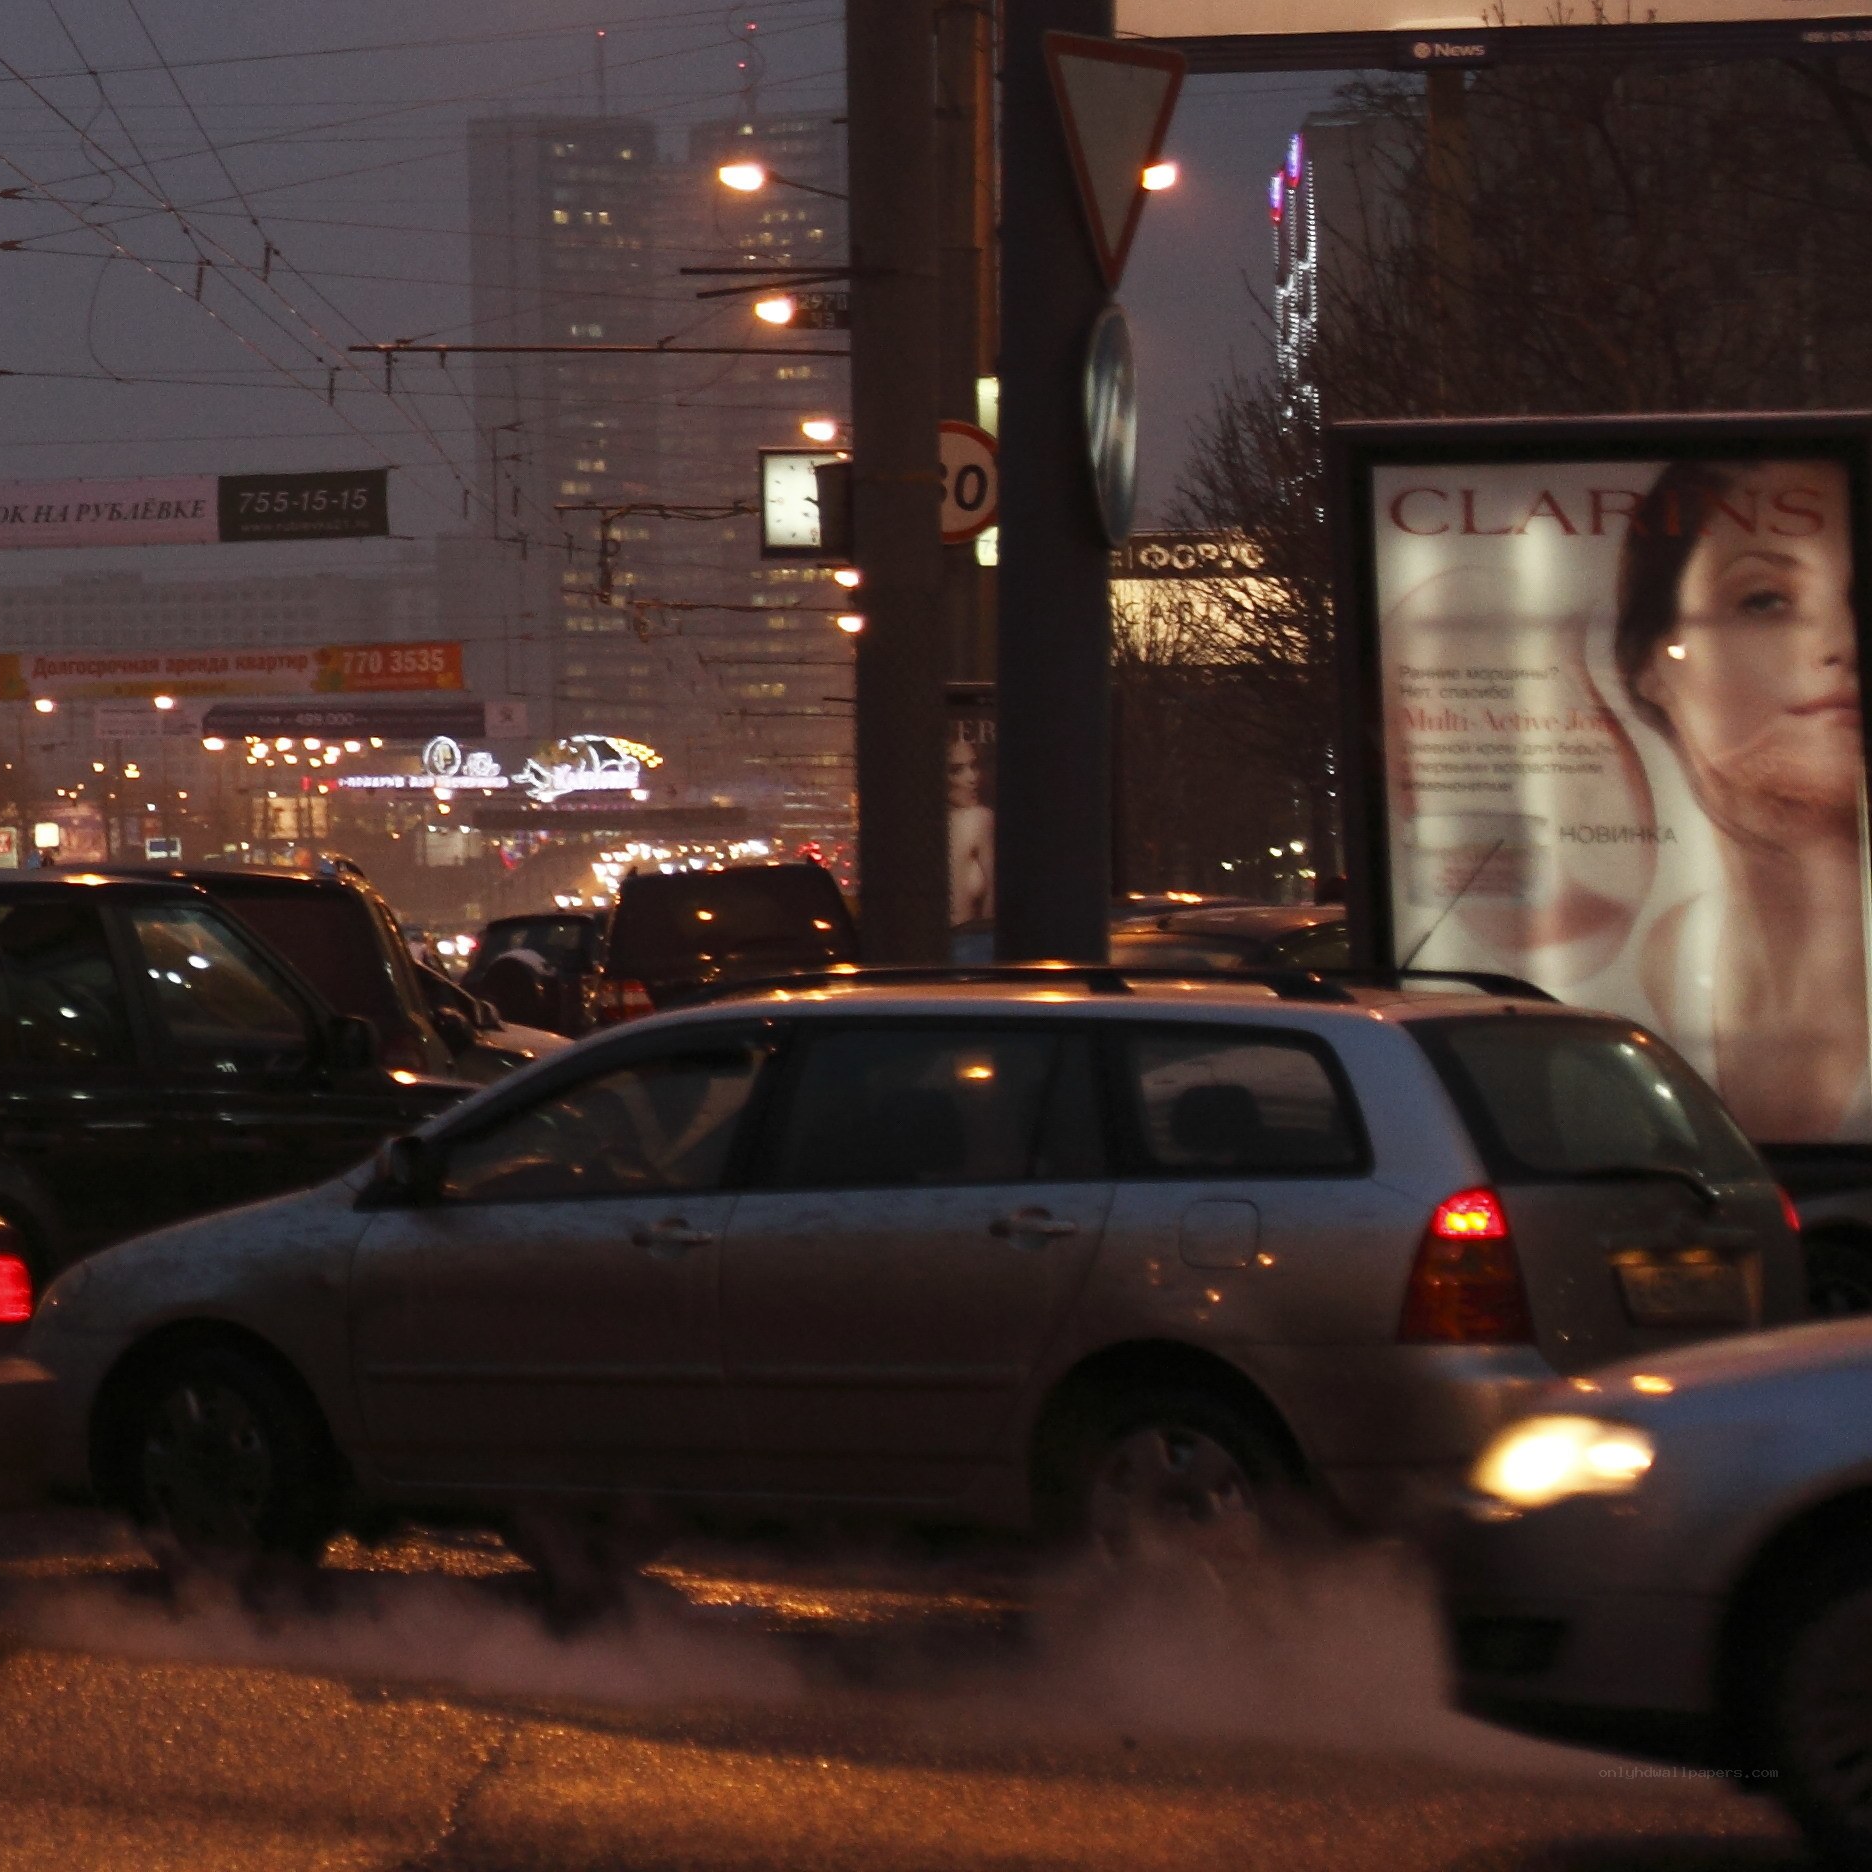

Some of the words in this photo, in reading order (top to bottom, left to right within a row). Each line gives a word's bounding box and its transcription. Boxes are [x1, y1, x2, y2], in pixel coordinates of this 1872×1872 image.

[32, 503, 71, 524] НА
[75, 498, 208, 523] РУБЛЁВКЕ
[238, 487, 369, 515] 755-15-15
[1388, 487, 1825, 537] CLARINS
[31, 657, 160, 679] Долгосрочная
[165, 657, 230, 677] аренда
[235, 655, 309, 673] квартир
[342, 651, 383, 674] 770
[389, 648, 446, 673] 3535
[1560, 826, 1678, 844] НОВИНКА
